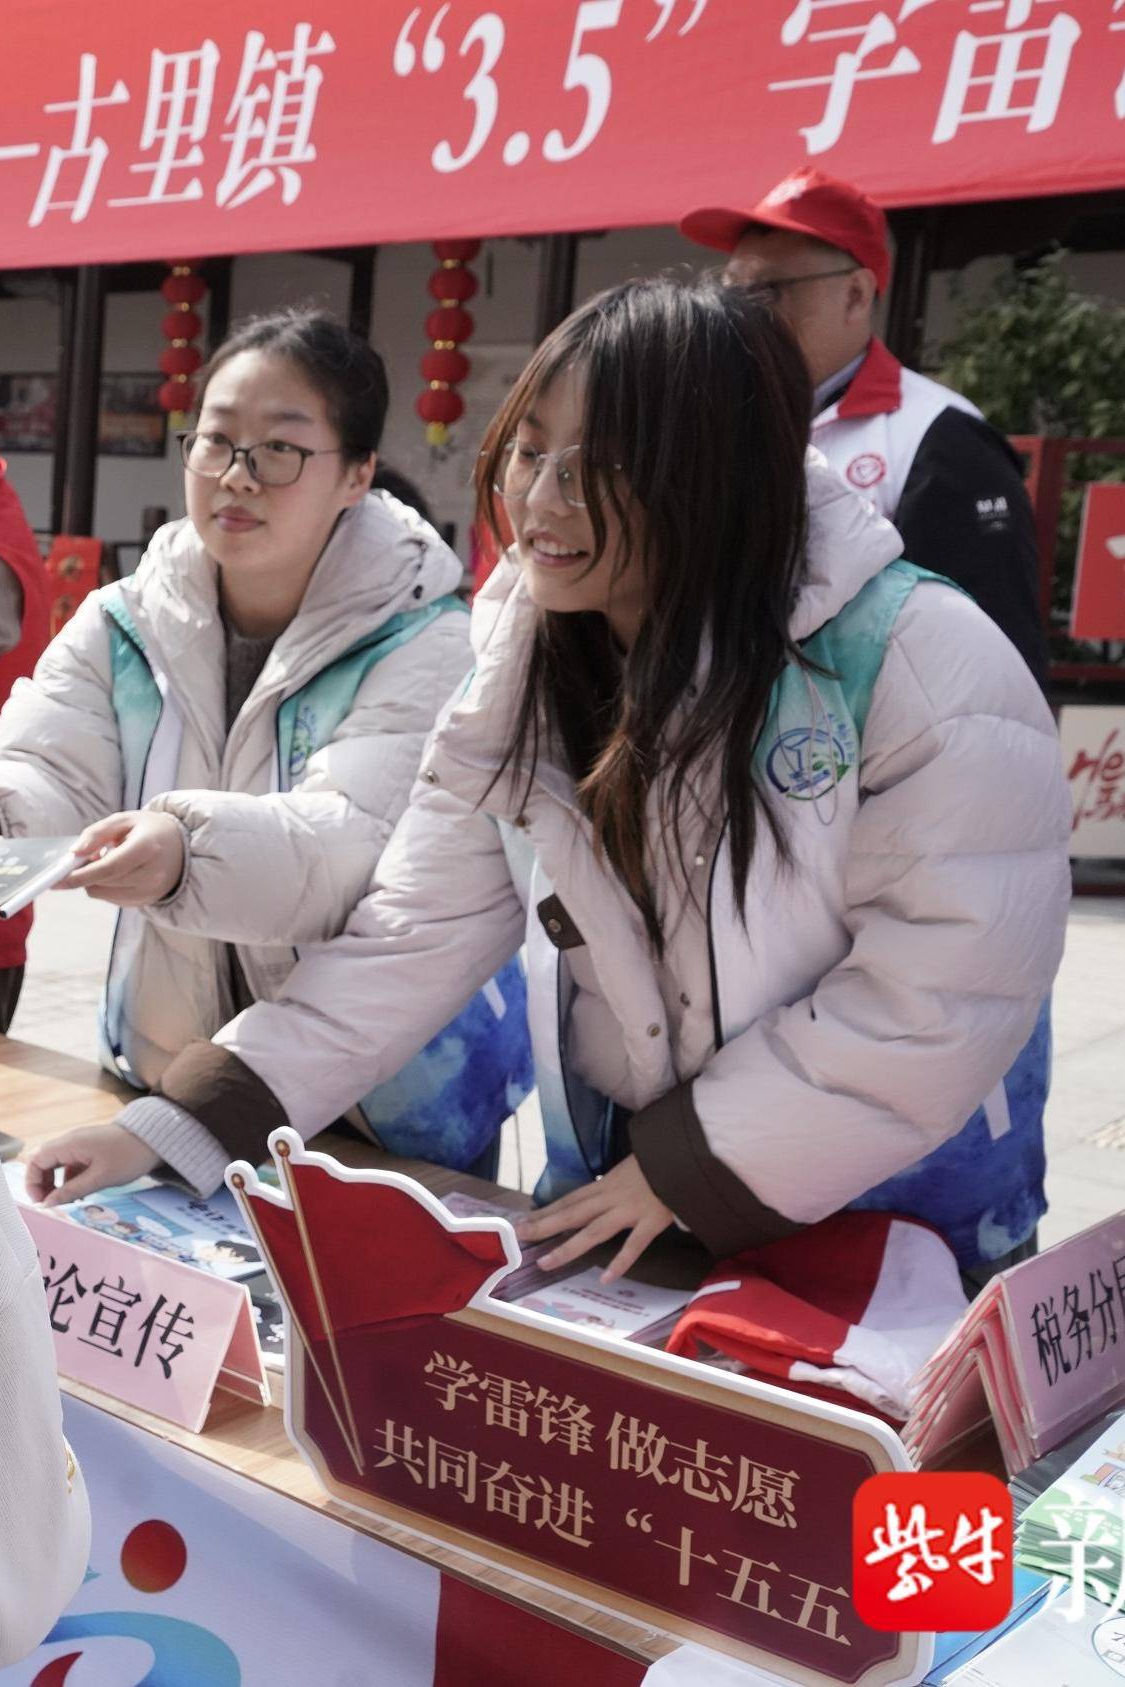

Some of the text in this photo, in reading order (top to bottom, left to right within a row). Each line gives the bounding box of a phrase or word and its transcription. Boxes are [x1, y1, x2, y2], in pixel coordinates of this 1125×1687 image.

[424, 1350, 800, 1530] 学雷锋 做志愿
